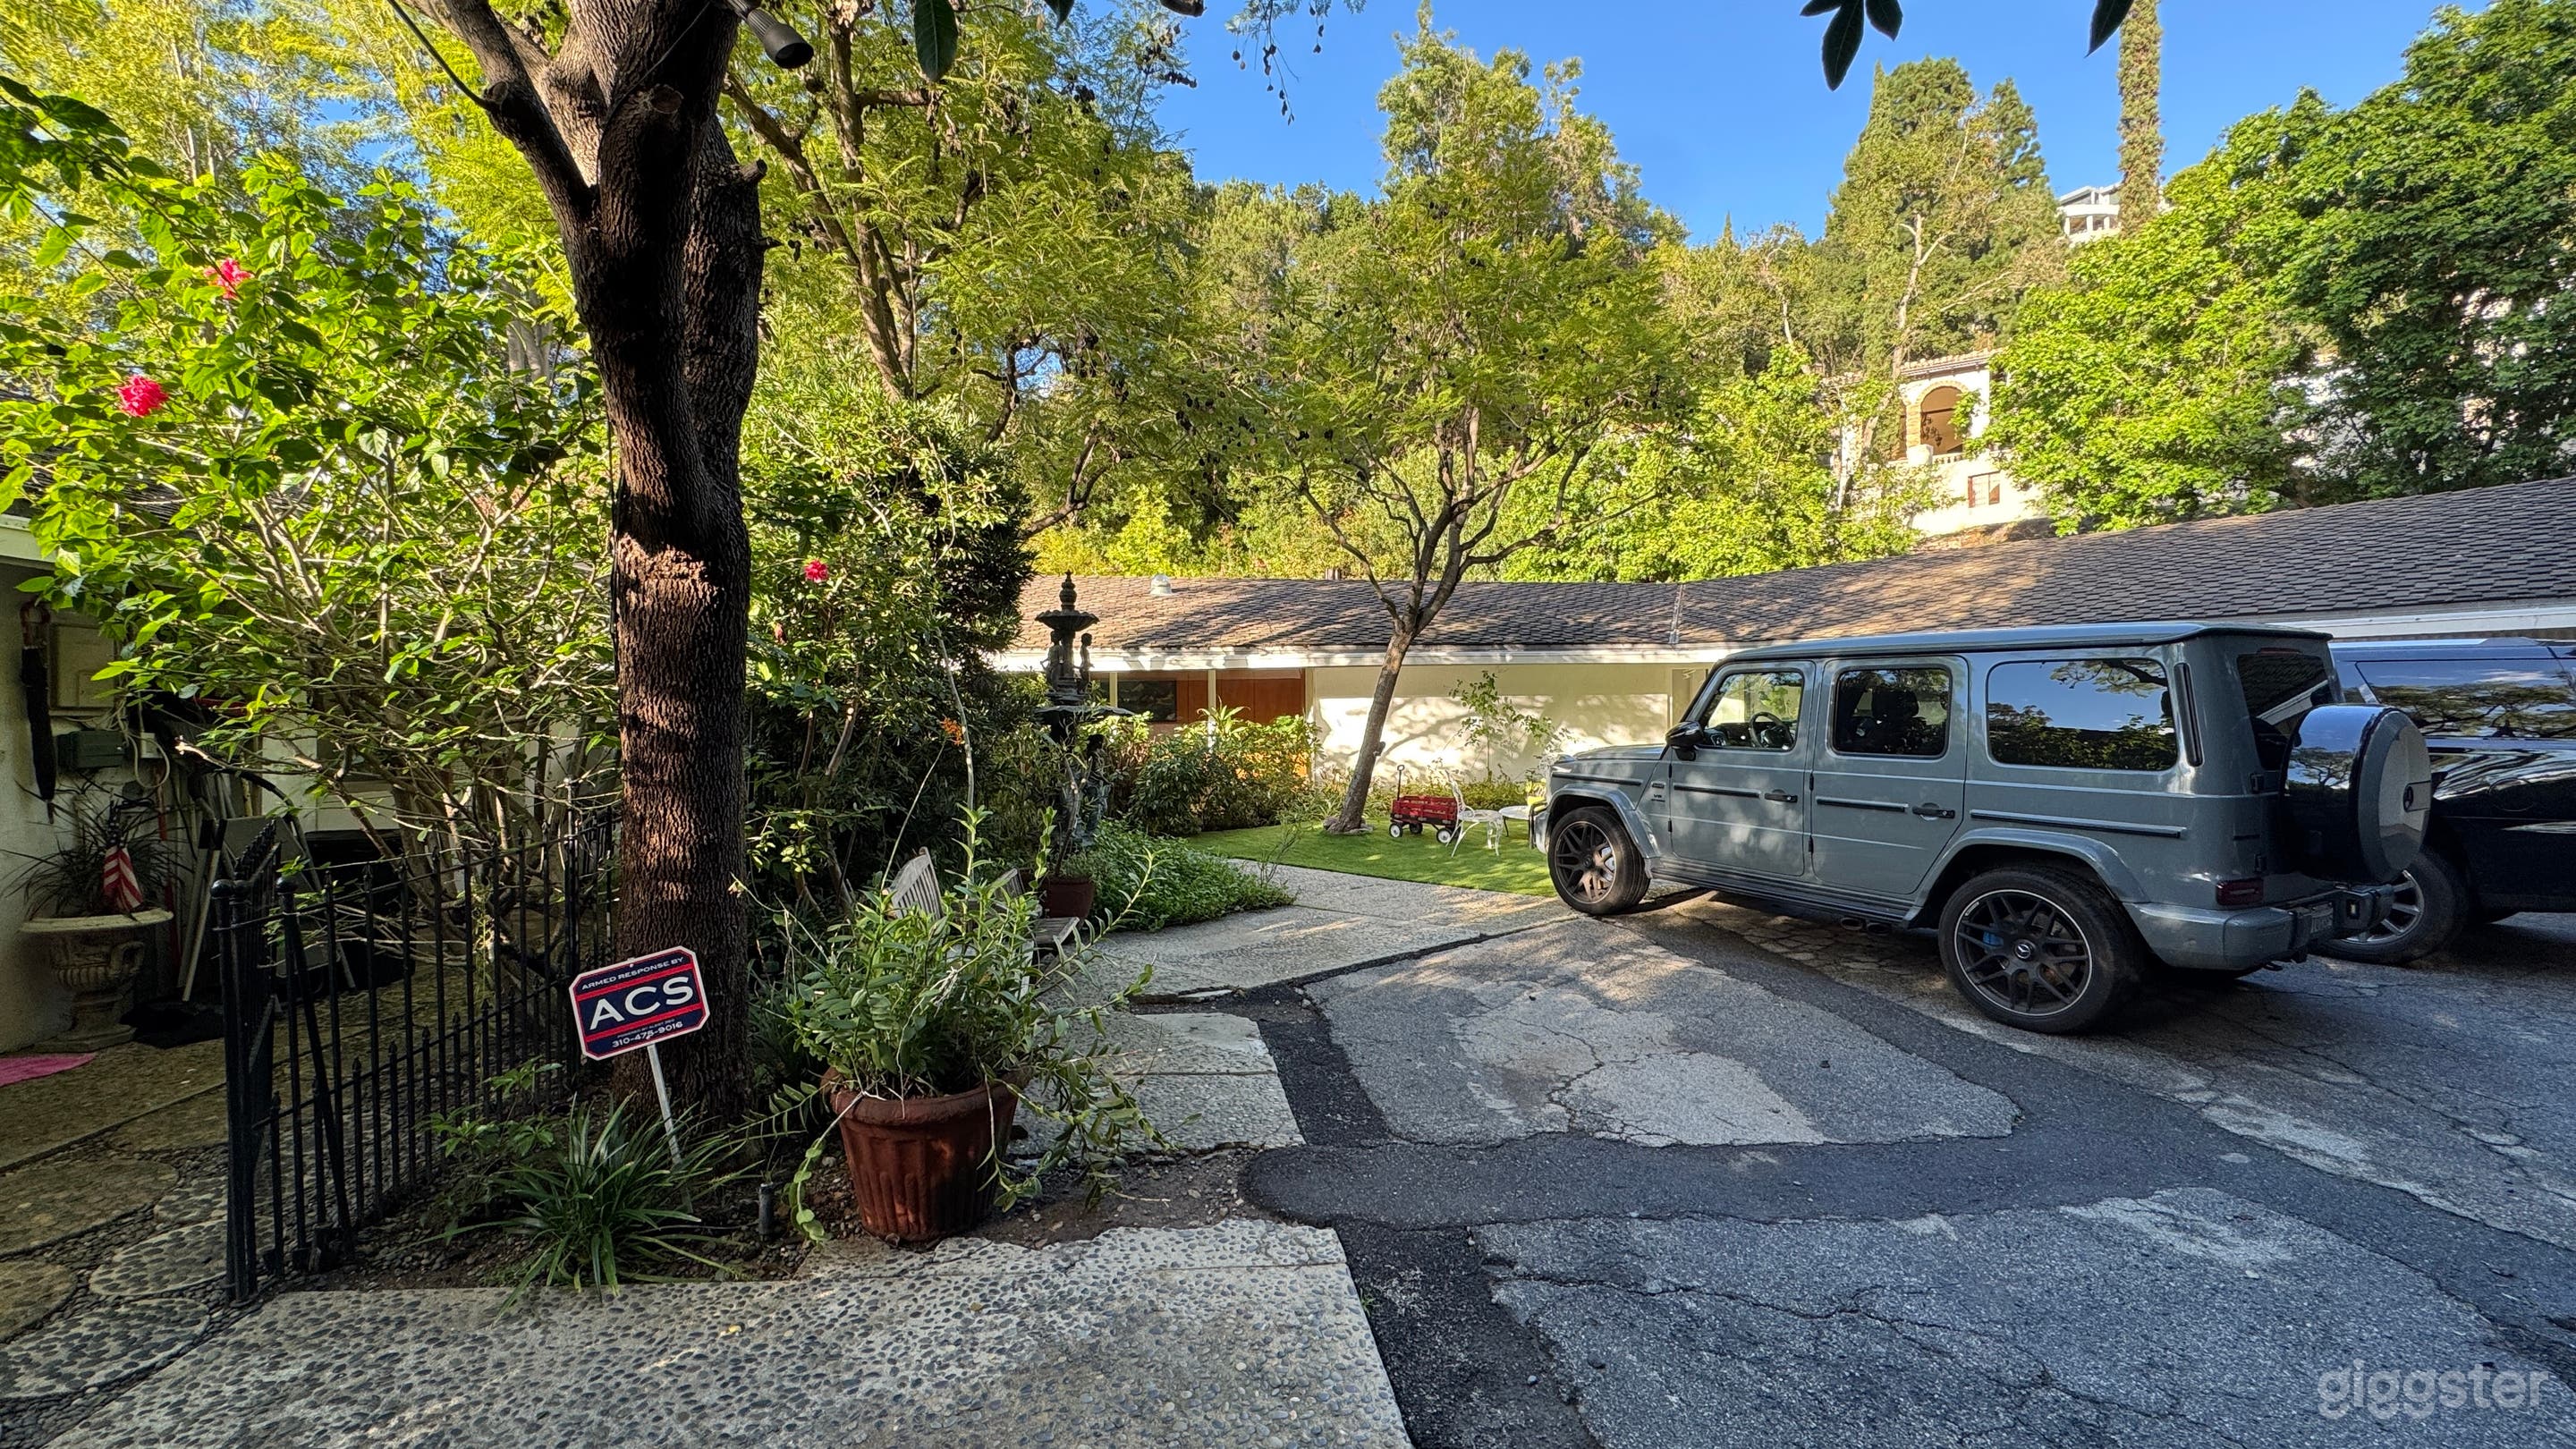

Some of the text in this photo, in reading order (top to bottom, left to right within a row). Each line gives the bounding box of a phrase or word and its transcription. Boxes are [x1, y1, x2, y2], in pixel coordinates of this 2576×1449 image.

[581, 956, 684, 990] ARMED RESPONSE BY
[589, 976, 694, 1030] ACS
[612, 1021, 683, 1048] 310-475-9016
